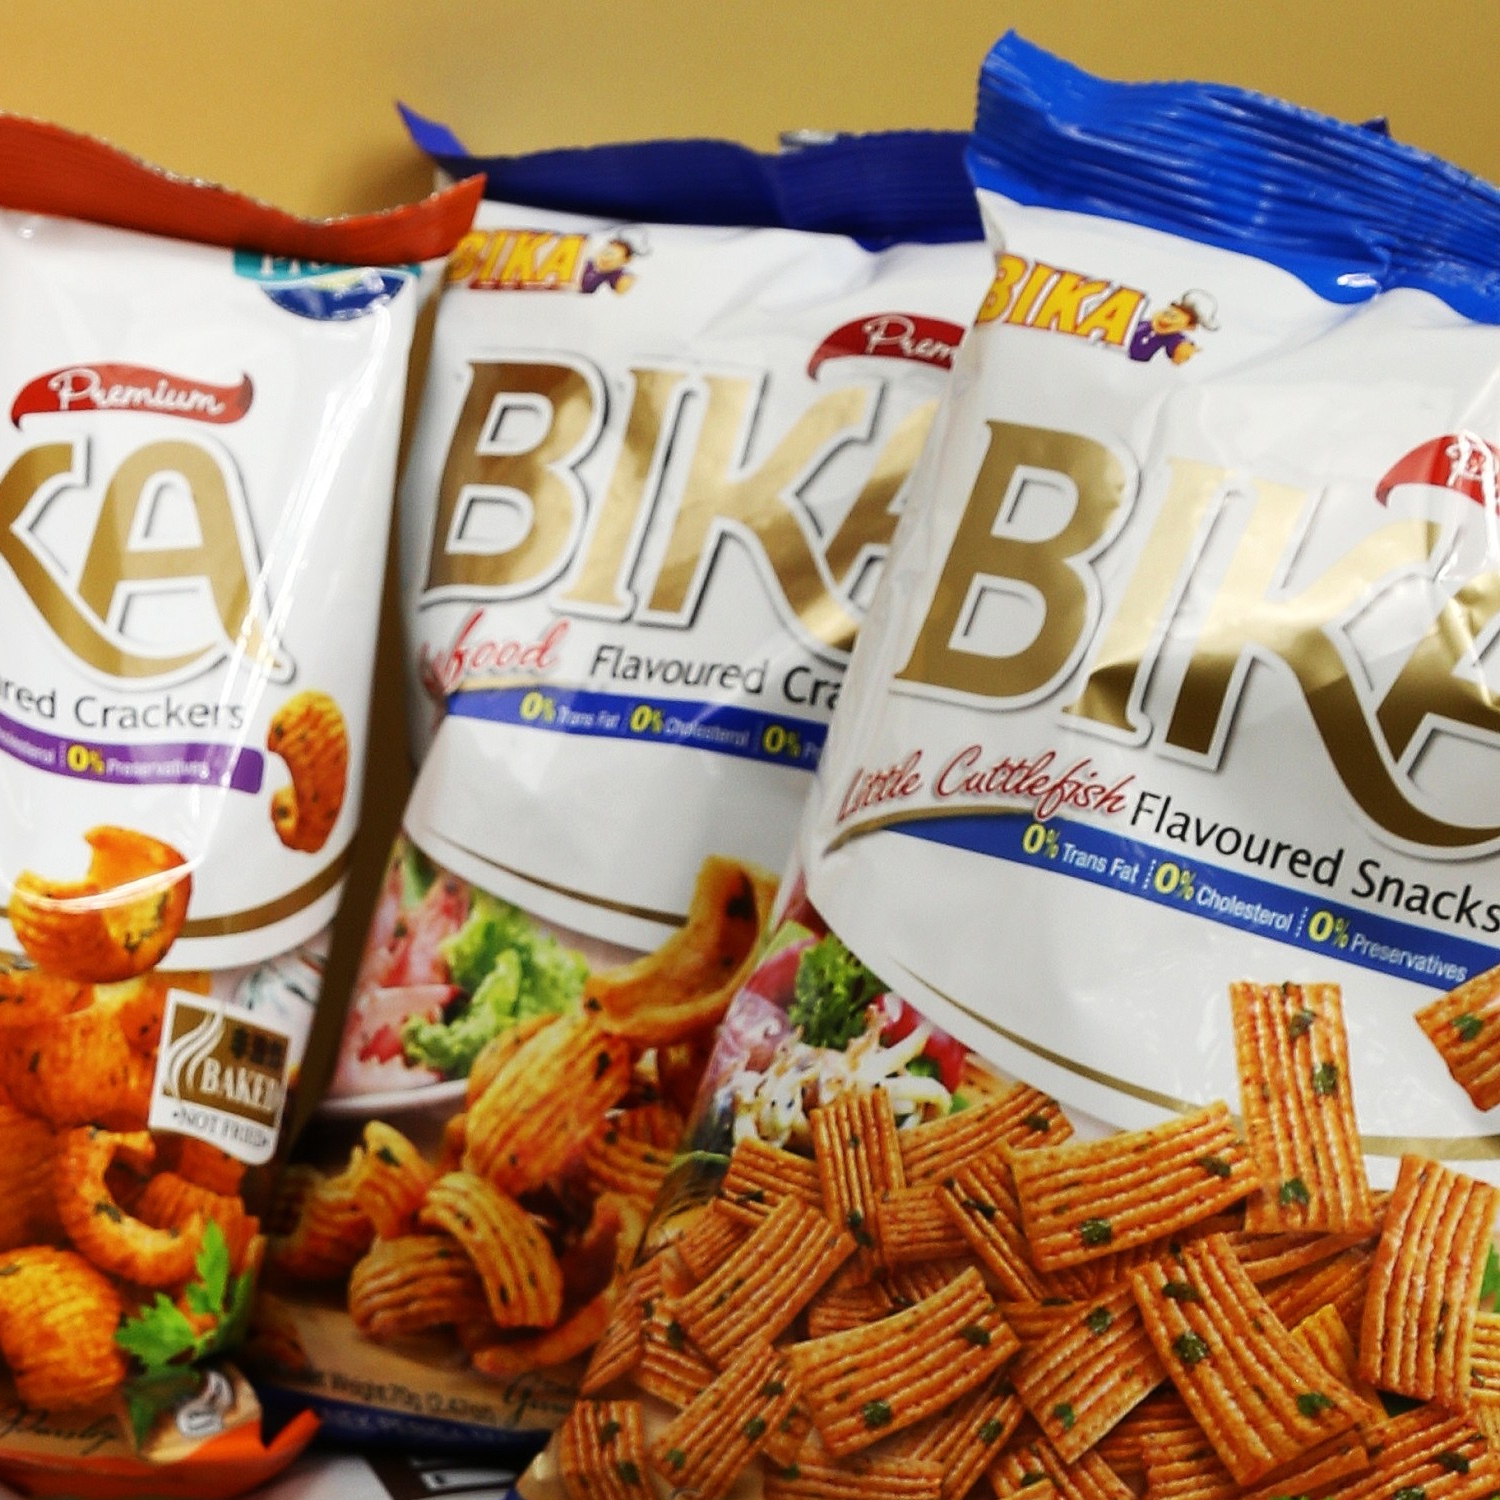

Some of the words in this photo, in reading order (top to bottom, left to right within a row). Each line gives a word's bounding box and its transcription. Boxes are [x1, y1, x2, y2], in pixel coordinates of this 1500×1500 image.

[975, 252, 1146, 347] BIKA
[862, 314, 953, 361] Prem
[47, 367, 226, 416] Premium
[589, 644, 770, 695] Flavoured
[74, 695, 244, 730] Crackers
[519, 690, 557, 723] 0%
[629, 703, 663, 735] 0%
[67, 744, 107, 775] 0%
[837, 749, 924, 824] Little
[935, 744, 1135, 822] Cuttlefish
[1129, 791, 1345, 888] Flavoured
[1351, 858, 1500, 934] Snacks
[1022, 822, 1060, 861] 0%
[1061, 842, 1107, 874] Trans
[1109, 854, 1141, 886] Fat
[1153, 862, 1196, 901] 0%
[1196, 885, 1294, 933] Cholesterol
[1307, 909, 1349, 950] 0%
[1350, 932, 1469, 984] Preservatives
